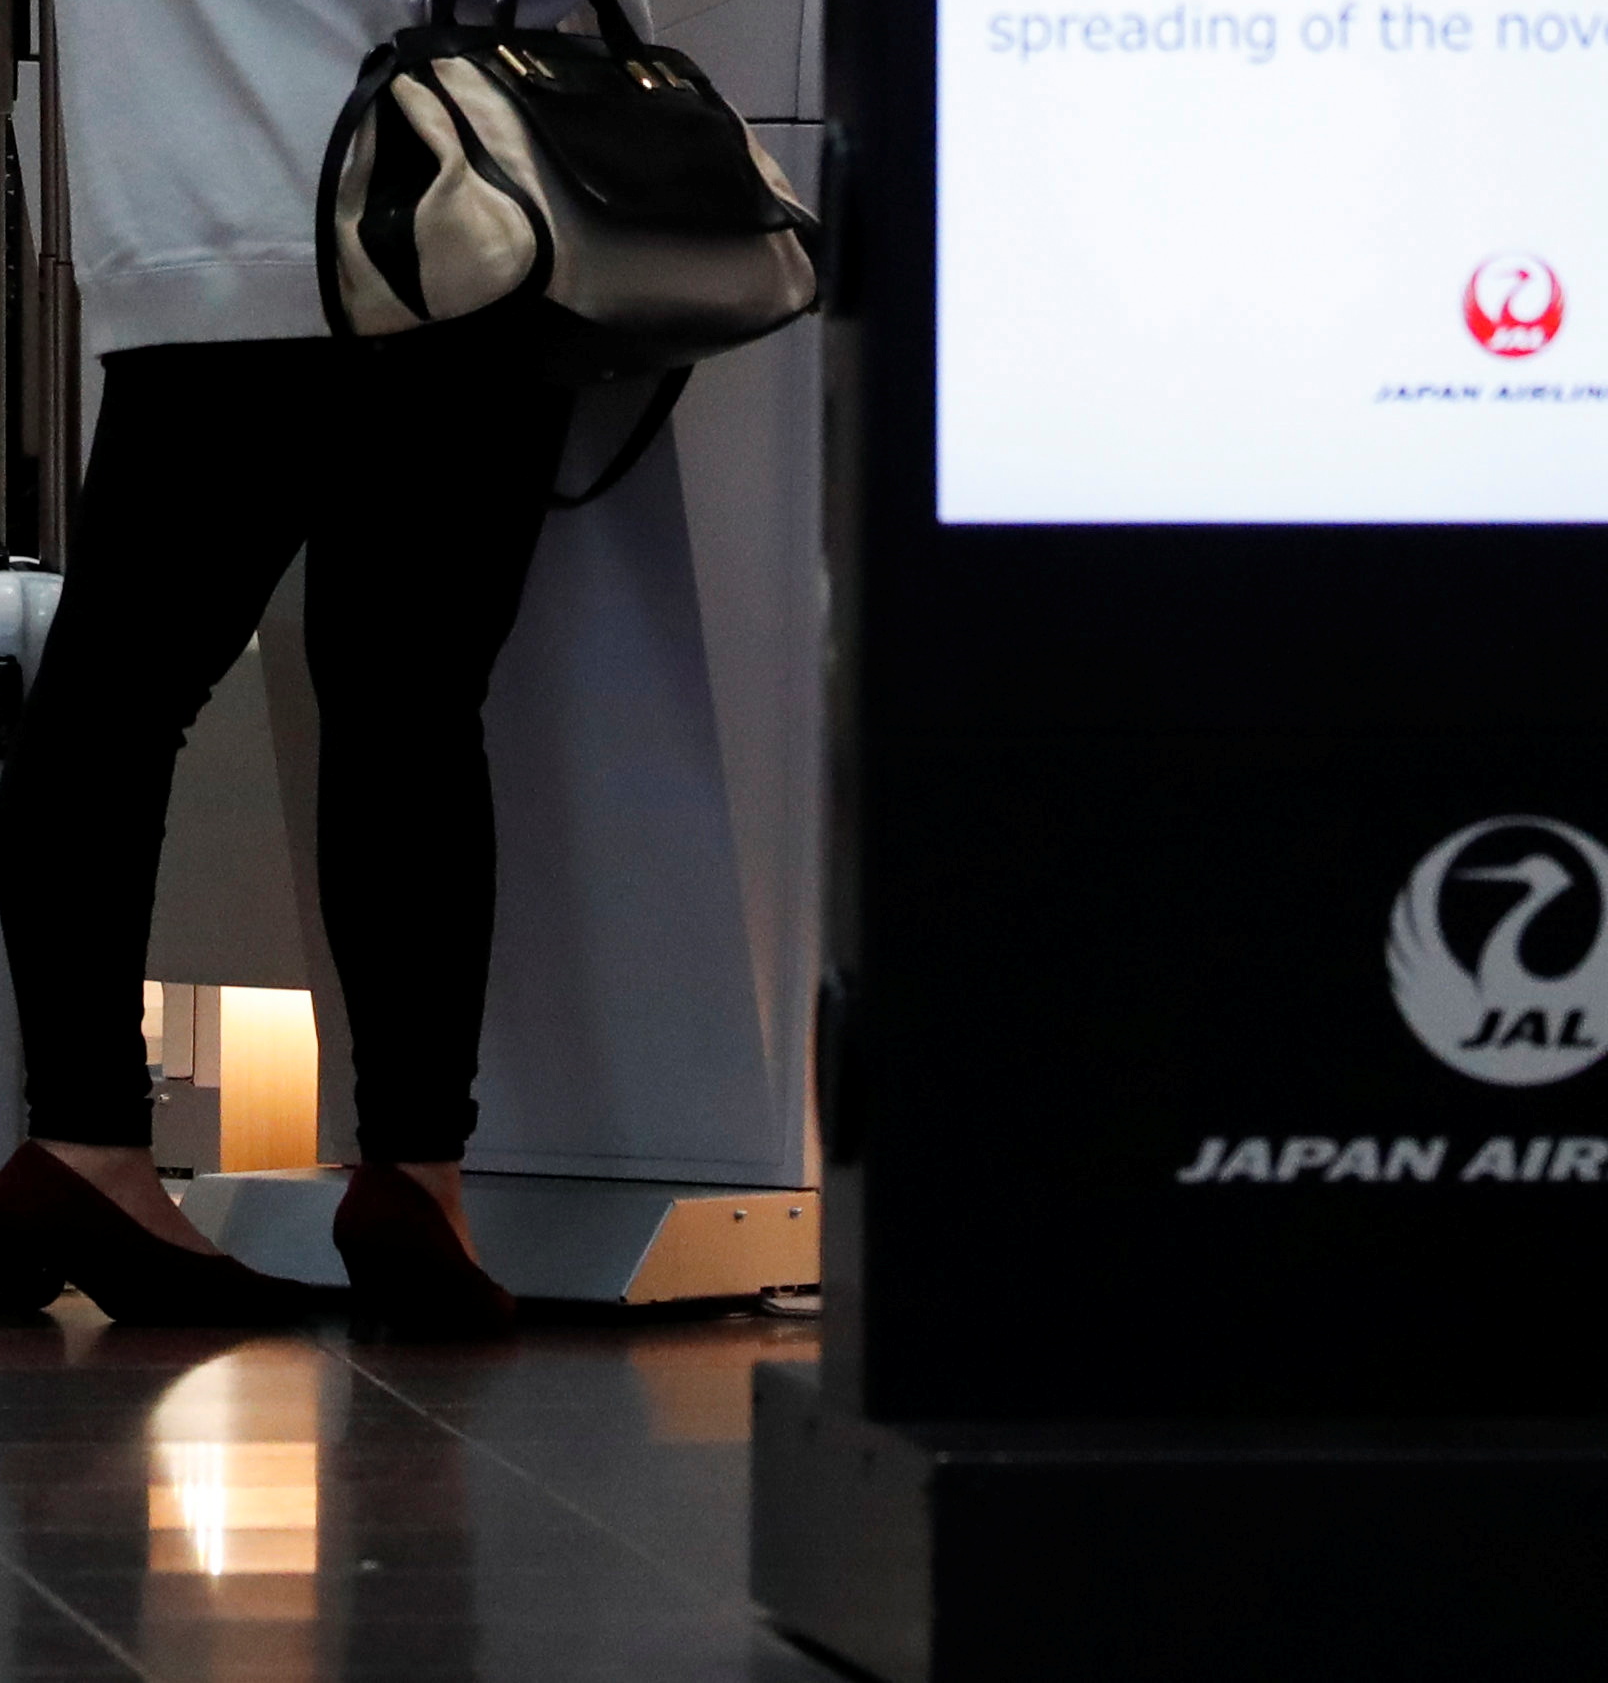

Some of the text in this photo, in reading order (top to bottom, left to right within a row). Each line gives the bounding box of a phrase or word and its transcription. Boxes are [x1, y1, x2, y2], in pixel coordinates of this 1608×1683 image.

[986, 4, 1278, 66] spreading
[1299, 1, 1357, 54] of
[1377, 4, 1475, 54] the
[1458, 1007, 1599, 1051] JAL
[1177, 1135, 1449, 1185] JAPAN
